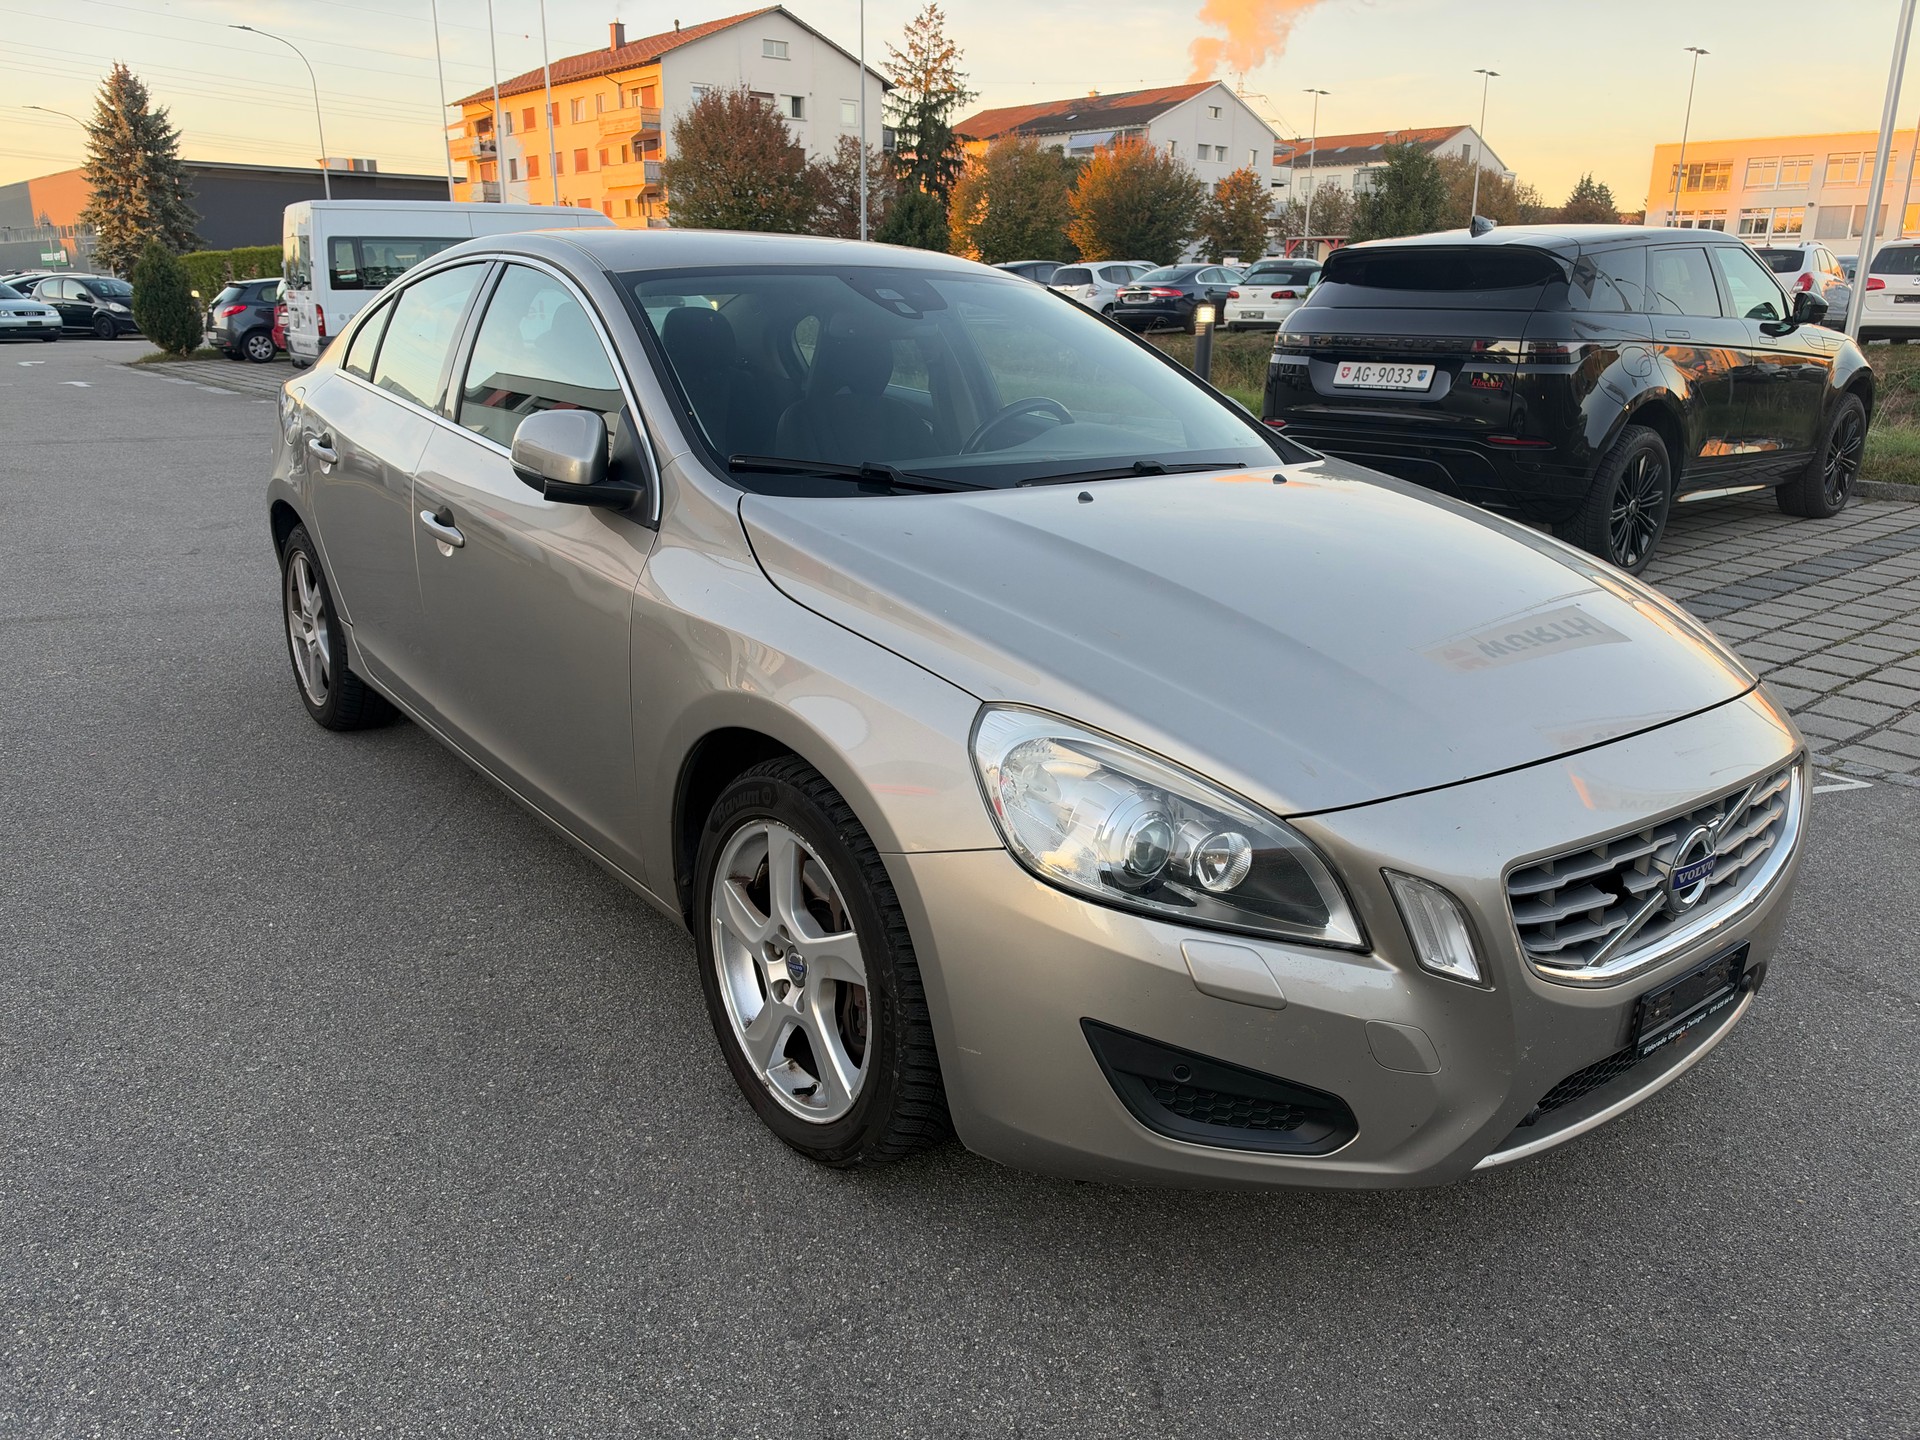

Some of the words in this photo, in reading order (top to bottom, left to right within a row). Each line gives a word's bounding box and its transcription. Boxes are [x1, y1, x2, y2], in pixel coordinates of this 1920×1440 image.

[1313, 336, 1375, 347] RANGE
[1388, 338, 1463, 349] ROVER
[1677, 860, 1714, 883] VOLVO
